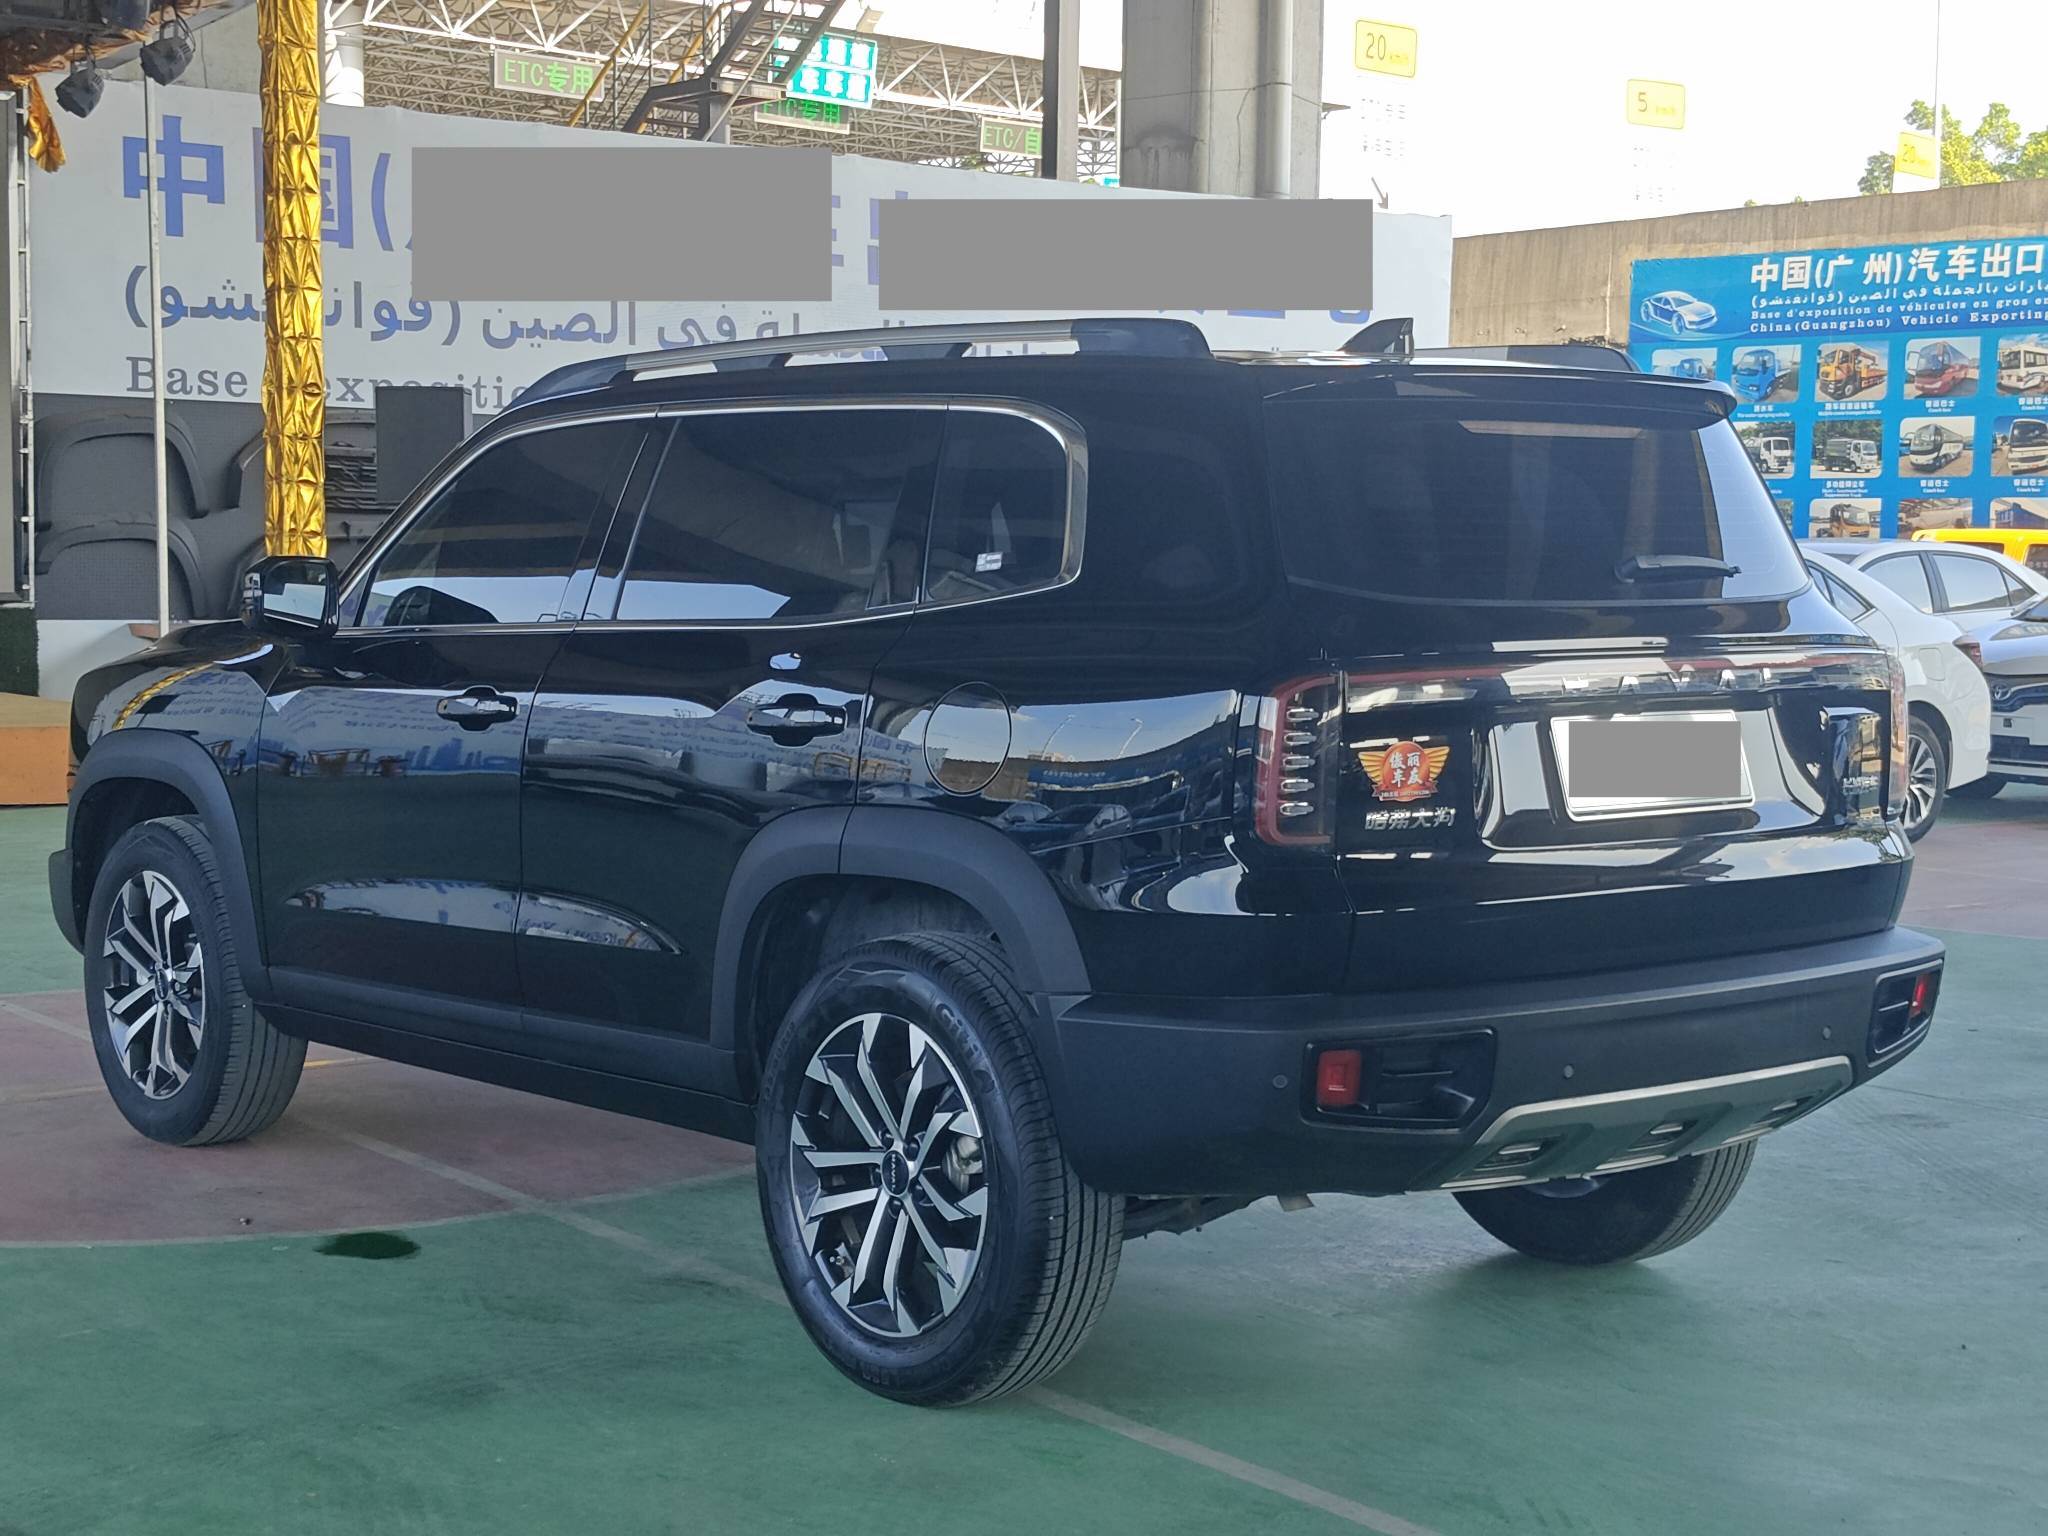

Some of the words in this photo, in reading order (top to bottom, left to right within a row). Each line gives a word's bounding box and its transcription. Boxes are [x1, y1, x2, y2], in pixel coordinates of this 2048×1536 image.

[1365, 32, 1386, 61] 20
[504, 59, 594, 94] ETC专用
[1637, 91, 1648, 112] 5
[1751, 311, 1781, 320] Base
[1877, 304, 1893, 314] de
[1973, 299, 1989, 309] en
[1996, 296, 2028, 310] gros
[1901, 314, 1959, 326] Vehicle
[126, 356, 248, 398] Base
